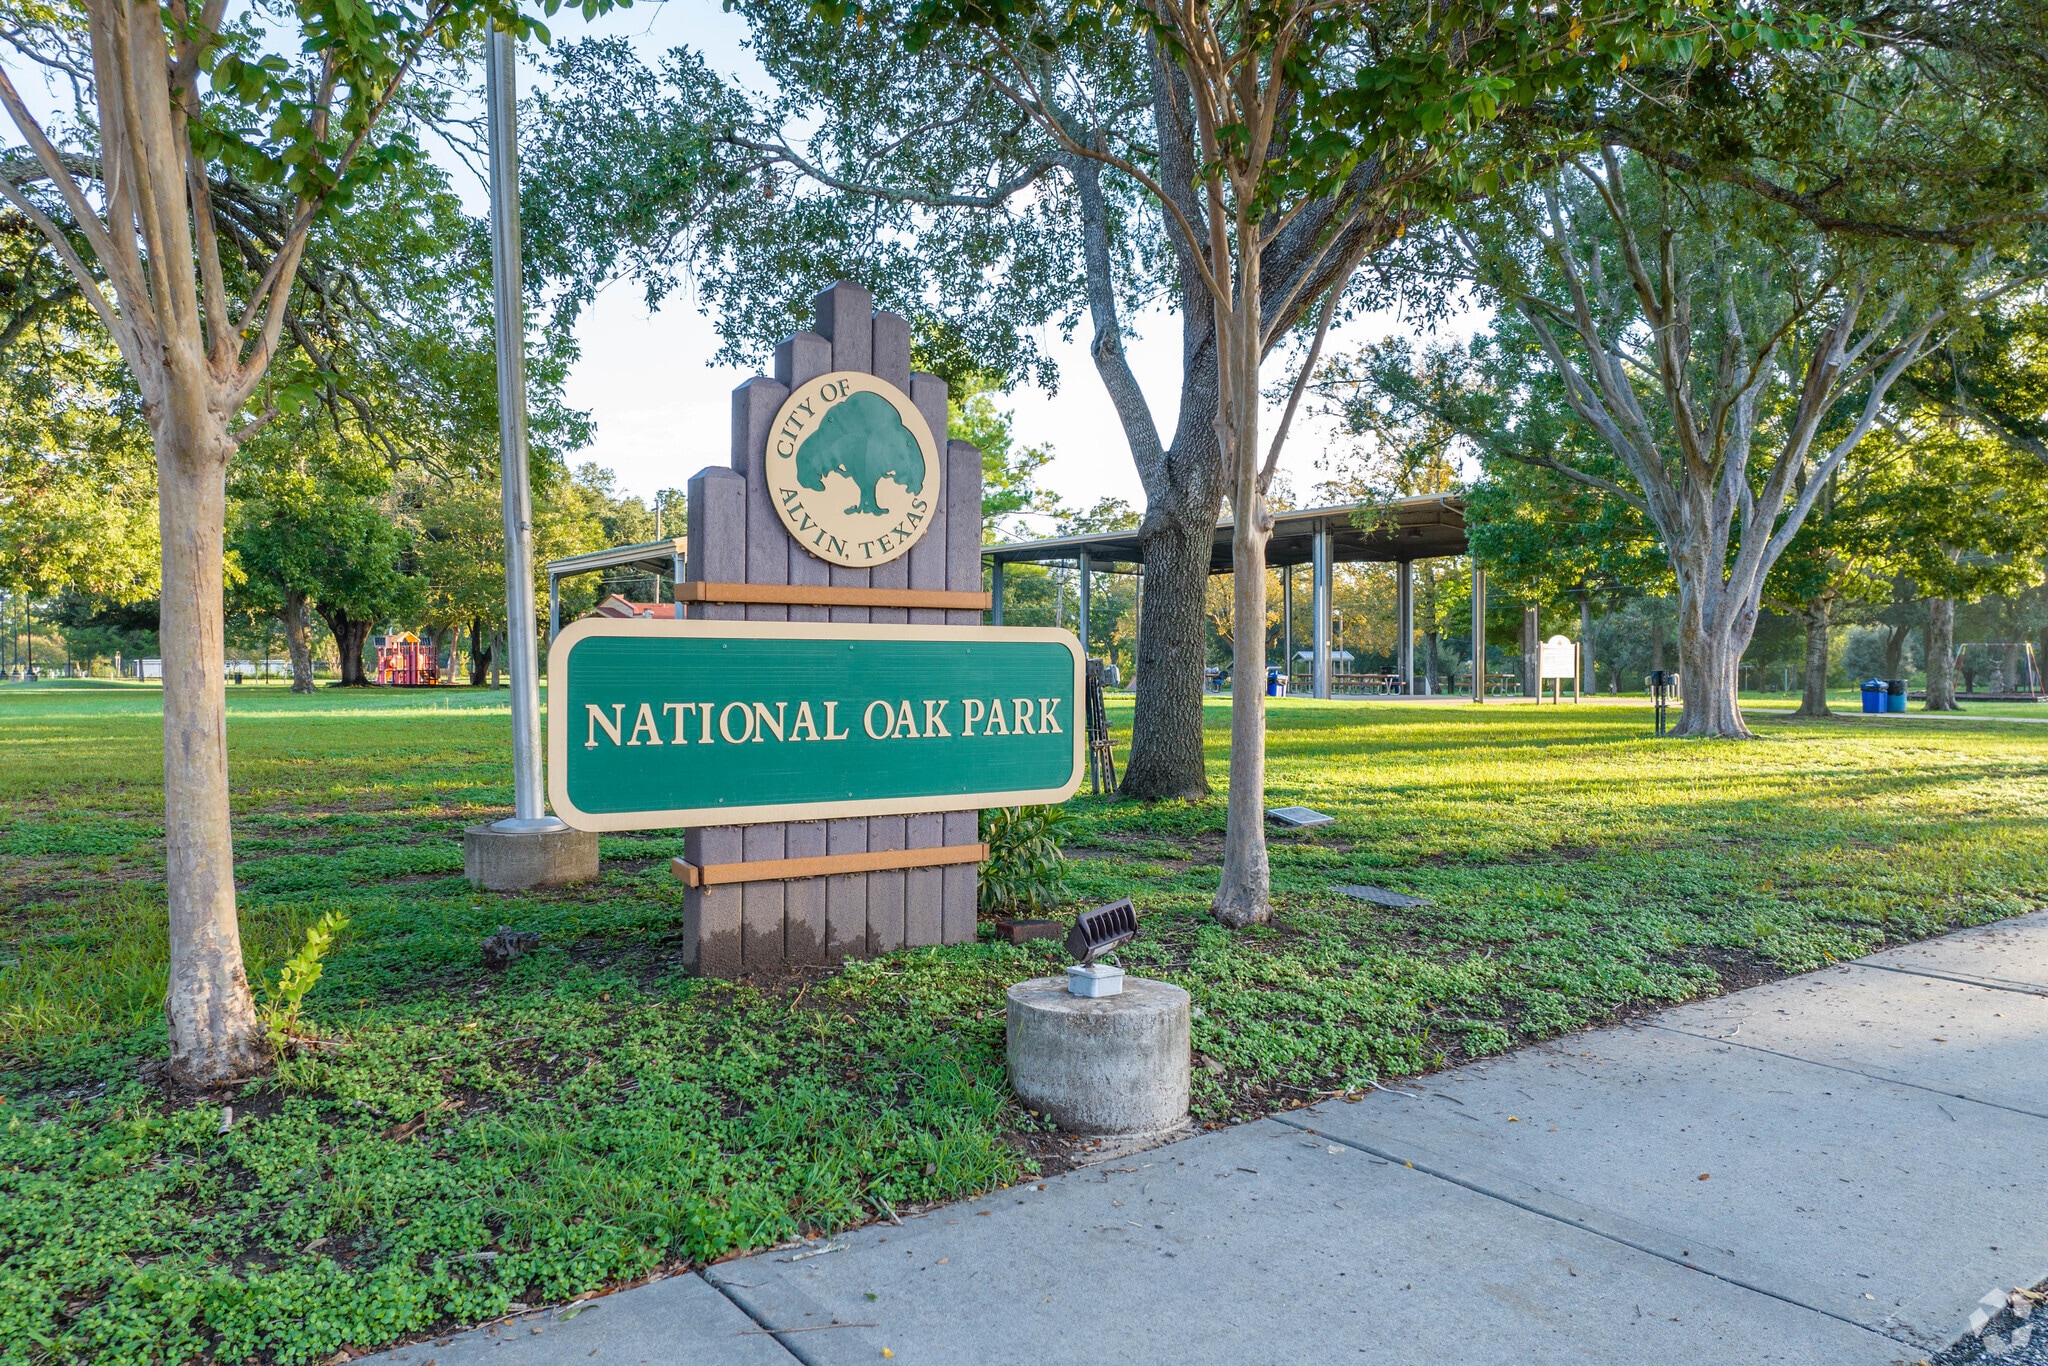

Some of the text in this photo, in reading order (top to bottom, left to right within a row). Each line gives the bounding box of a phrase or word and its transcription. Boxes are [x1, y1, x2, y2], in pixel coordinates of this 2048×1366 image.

[777, 378, 850, 459] CITY OF
[779, 486, 928, 560] ALVIN, TEXAS
[584, 697, 1063, 748] NATIONAL OAK PARK
